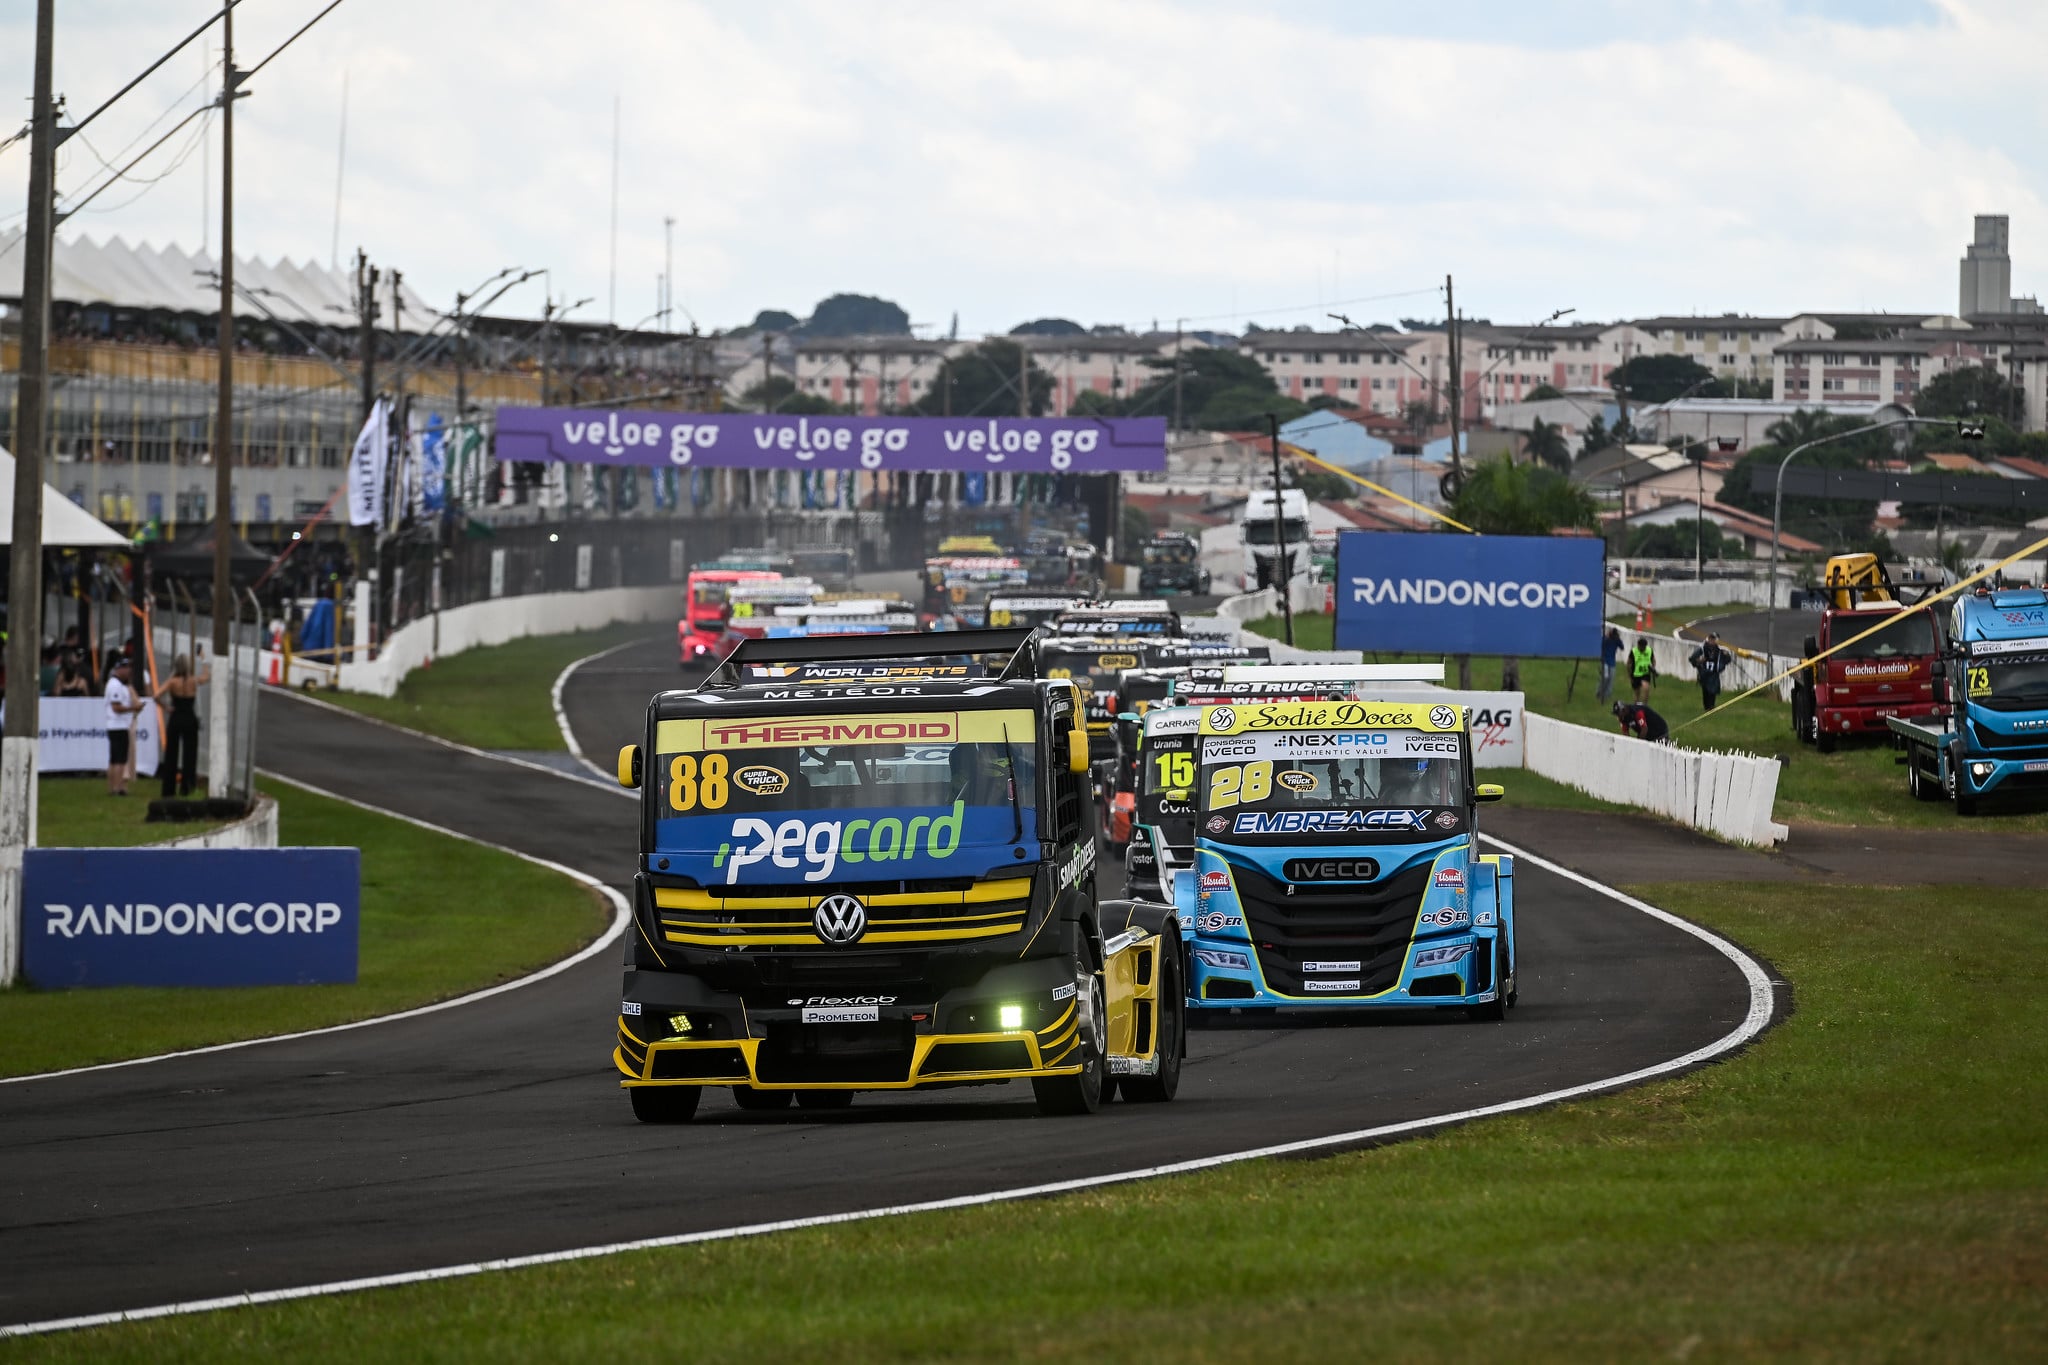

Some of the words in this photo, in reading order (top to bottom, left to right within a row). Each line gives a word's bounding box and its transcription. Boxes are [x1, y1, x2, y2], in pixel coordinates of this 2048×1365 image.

[563, 412, 662, 455] veloe
[670, 424, 719, 464] go
[754, 417, 852, 460] veloe
[860, 428, 909, 468] go
[944, 420, 1042, 462] veloe
[1050, 429, 1098, 470] go
[1352, 577, 1590, 608] RANDONCORP
[804, 666, 969, 678] WORLDPARTS
[1705, 661, 1715, 671] 17
[1845, 664, 1877, 676] Guinchos
[1877, 662, 1909, 674] Londrina
[1968, 668, 1989, 689] 73
[763, 687, 922, 700] METEOR
[1248, 706, 1328, 728] Sodiê
[1331, 703, 1413, 726] Doces
[711, 722, 953, 745] THERMOID
[1288, 733, 1389, 747] NEXPRO
[1153, 739, 1183, 749] Urania
[1205, 746, 1256, 758] IVECO
[1405, 743, 1458, 753] IVECO
[743, 770, 768, 779] SUPER
[1155, 752, 1195, 788] 15
[669, 753, 729, 811] 88
[747, 775, 779, 786] TRUCK
[760, 784, 783, 793] PRO
[1208, 760, 1274, 811] 28
[1233, 809, 1433, 834] EMBREAGEX
[1294, 862, 1373, 879] IVECO
[44, 902, 342, 938] RANDONCORP
[1197, 913, 1243, 929] CISER
[1420, 909, 1468, 926] CISER
[1307, 982, 1359, 990] PROMETEON
[806, 995, 898, 1005] Flexfab
[806, 1012, 876, 1022] PROMETEON
